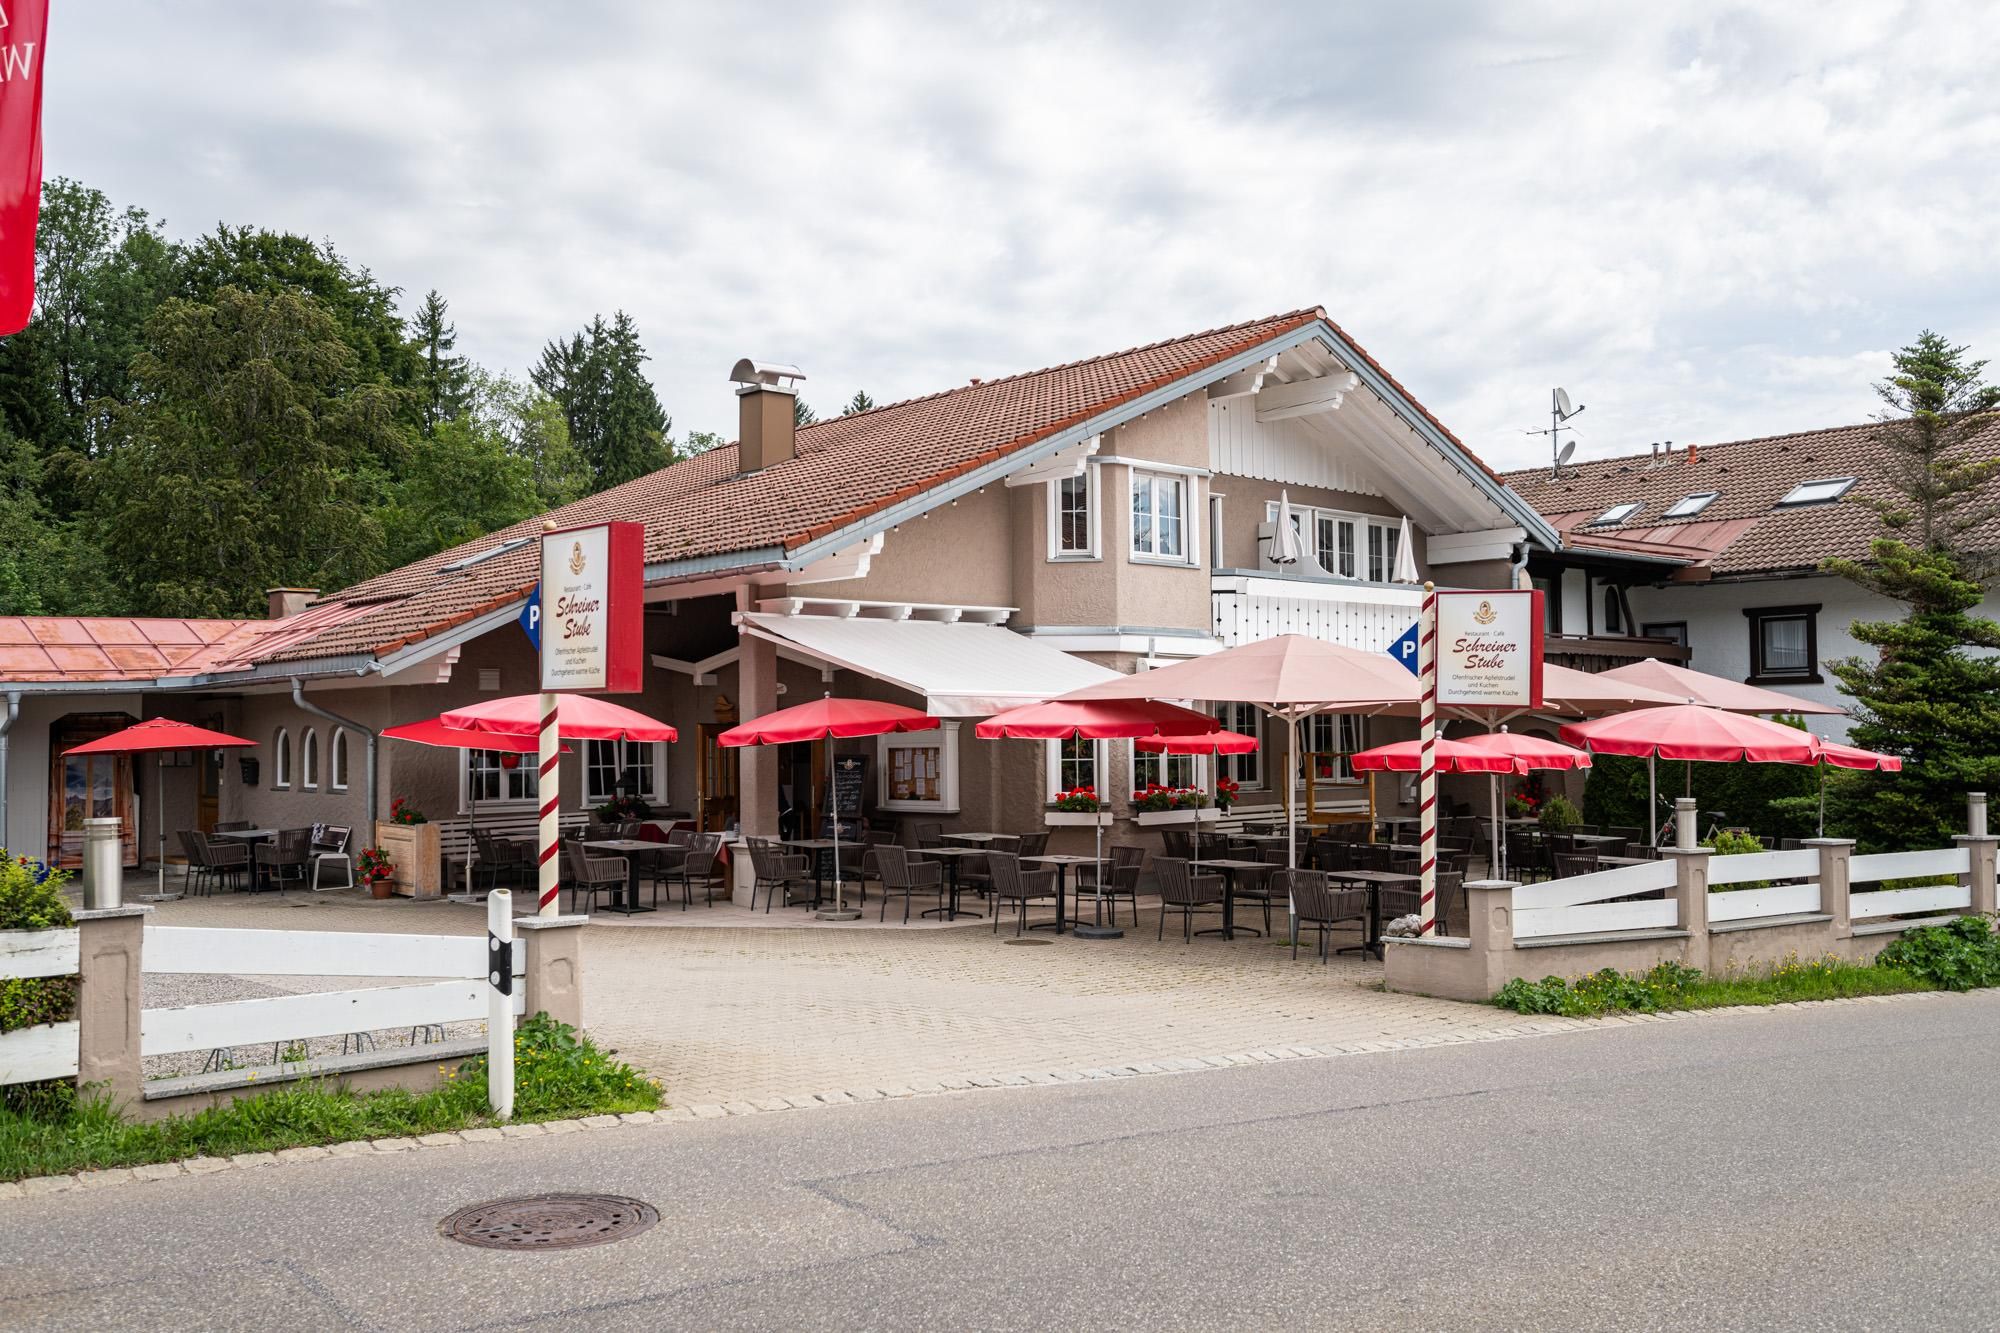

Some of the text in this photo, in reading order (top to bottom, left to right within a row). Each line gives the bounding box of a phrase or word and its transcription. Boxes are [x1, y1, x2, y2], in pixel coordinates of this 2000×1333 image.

[556, 593, 599, 618] Schreiner
[530, 605, 540, 630] P
[564, 616, 591, 639] Stube
[1402, 640, 1416, 658] P
[1452, 637, 1517, 653] Schreiner
[1464, 653, 1505, 669] Stube
